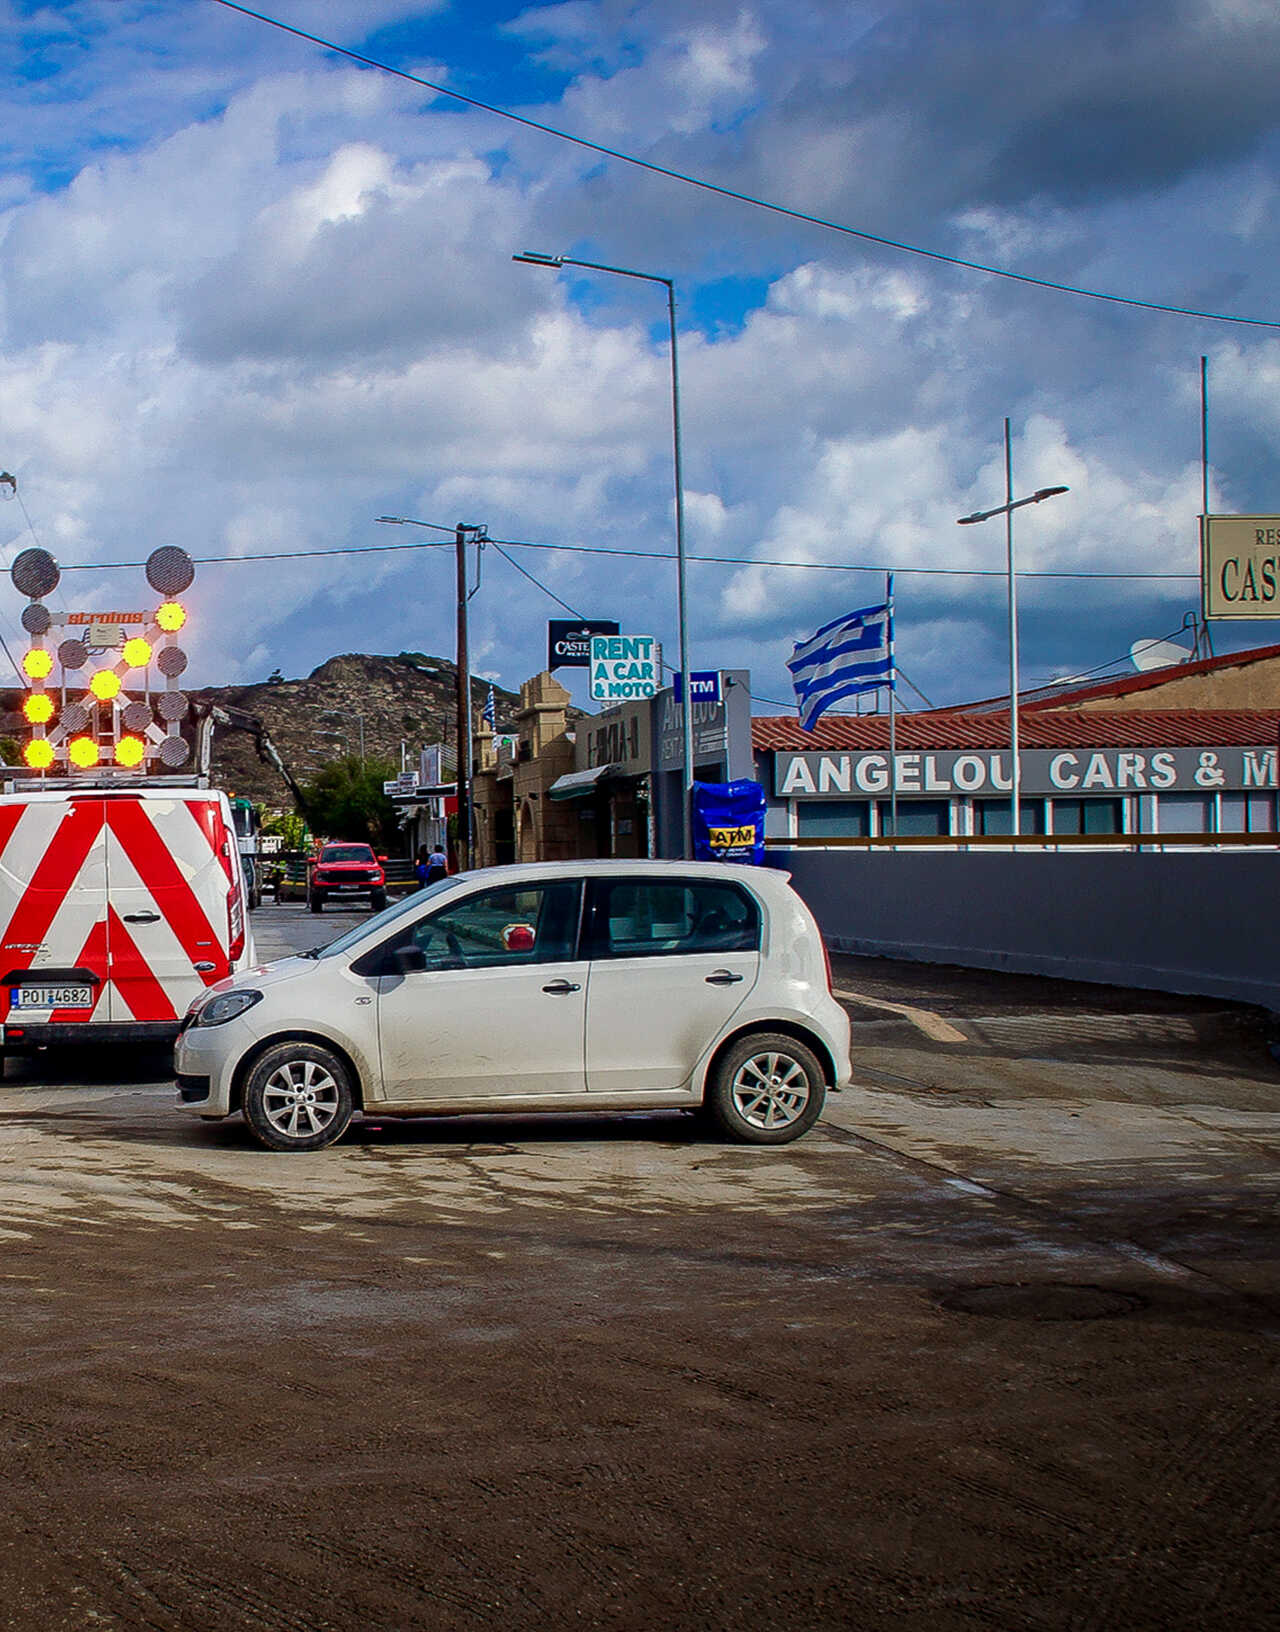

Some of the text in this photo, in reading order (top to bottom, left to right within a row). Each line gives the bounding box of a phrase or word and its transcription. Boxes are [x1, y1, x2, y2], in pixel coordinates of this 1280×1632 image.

[1221, 557, 1280, 602] CAS
[593, 638, 654, 660] RENT
[594, 662, 654, 680] A CAR
[594, 682, 655, 697] & MOTO
[689, 680, 715, 693] TM
[781, 754, 1020, 792] ANGELOU
[1049, 752, 1177, 789] CARS
[1194, 751, 1225, 787] &
[715, 829, 752, 845] ATM
[55, 989, 88, 1002] 4682
